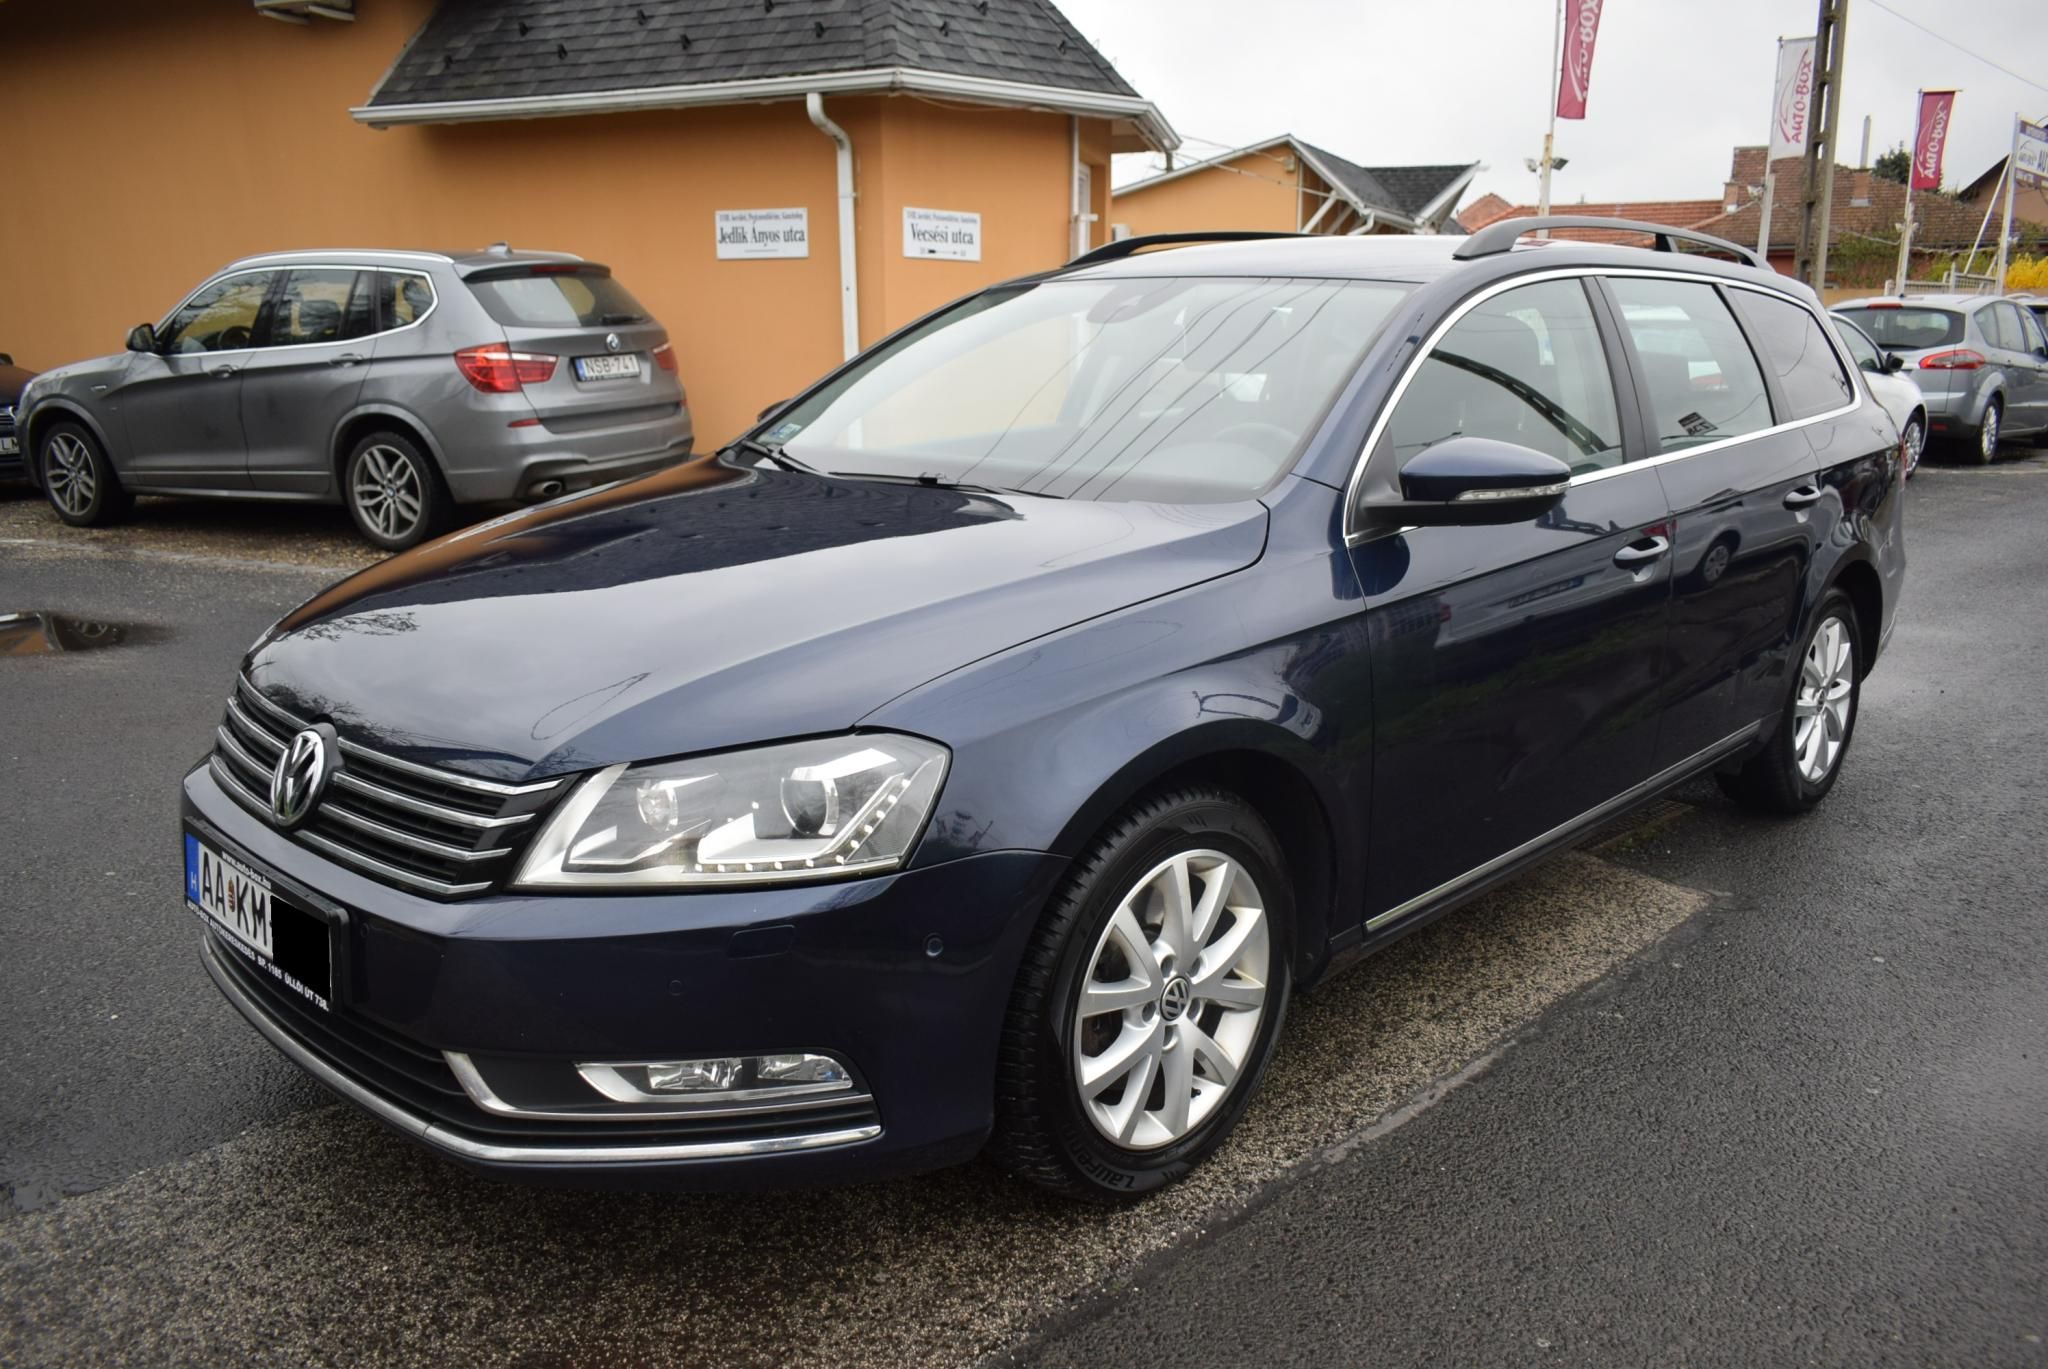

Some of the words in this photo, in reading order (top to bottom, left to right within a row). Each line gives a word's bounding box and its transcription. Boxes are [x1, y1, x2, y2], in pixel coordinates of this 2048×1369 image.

[1791, 60, 1813, 143] AUTO-BOX
[1924, 107, 1948, 178] AUTO-BOX
[719, 226, 749, 244] Jedlik
[751, 220, 781, 247] Ányos
[783, 227, 806, 242] utca
[951, 228, 974, 245] utca
[585, 355, 637, 374] NSB-741
[190, 871, 198, 892] H
[202, 851, 226, 918] AA
